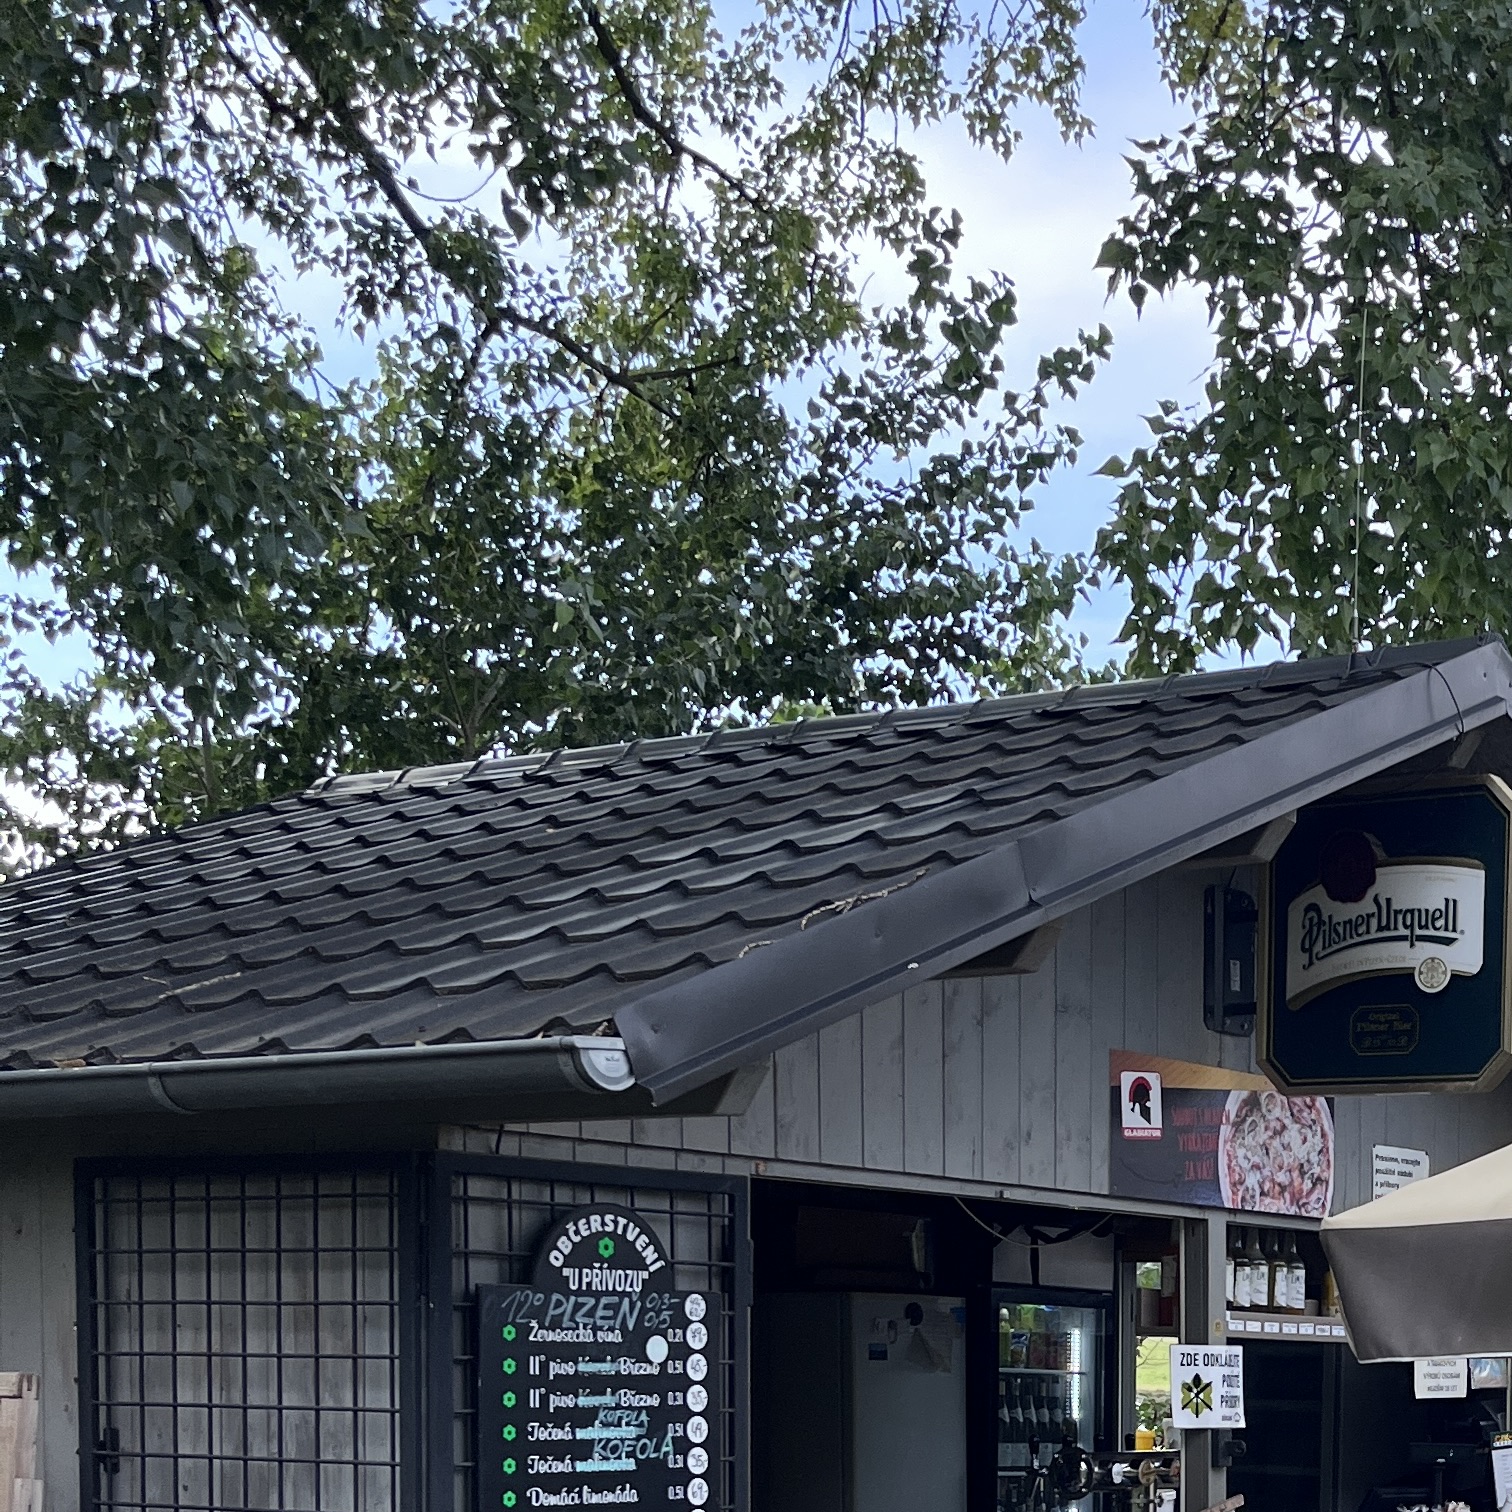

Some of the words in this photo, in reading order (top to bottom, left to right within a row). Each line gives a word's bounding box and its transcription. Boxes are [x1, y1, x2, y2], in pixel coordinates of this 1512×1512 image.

[1301, 902, 1375, 971] Pilsner
[1373, 893, 1458, 949] Urquell
[1124, 1129, 1161, 1137] GLADIATOR
[549, 1214, 666, 1272] OBČERSTVENÍ
[545, 1291, 642, 1331] PLZEŇ
[549, 1358, 576, 1380] pivo
[617, 1356, 661, 1375] Březno
[1180, 1352, 1200, 1367] ZDE
[549, 1391, 576, 1412] pivo
[616, 1389, 661, 1408] Březno
[527, 1422, 573, 1441] Točená
[592, 1434, 675, 1460] KOFOLA
[527, 1454, 573, 1474] Točená
[526, 1486, 581, 1506] Domácí
[582, 1483, 639, 1504] limonáda
